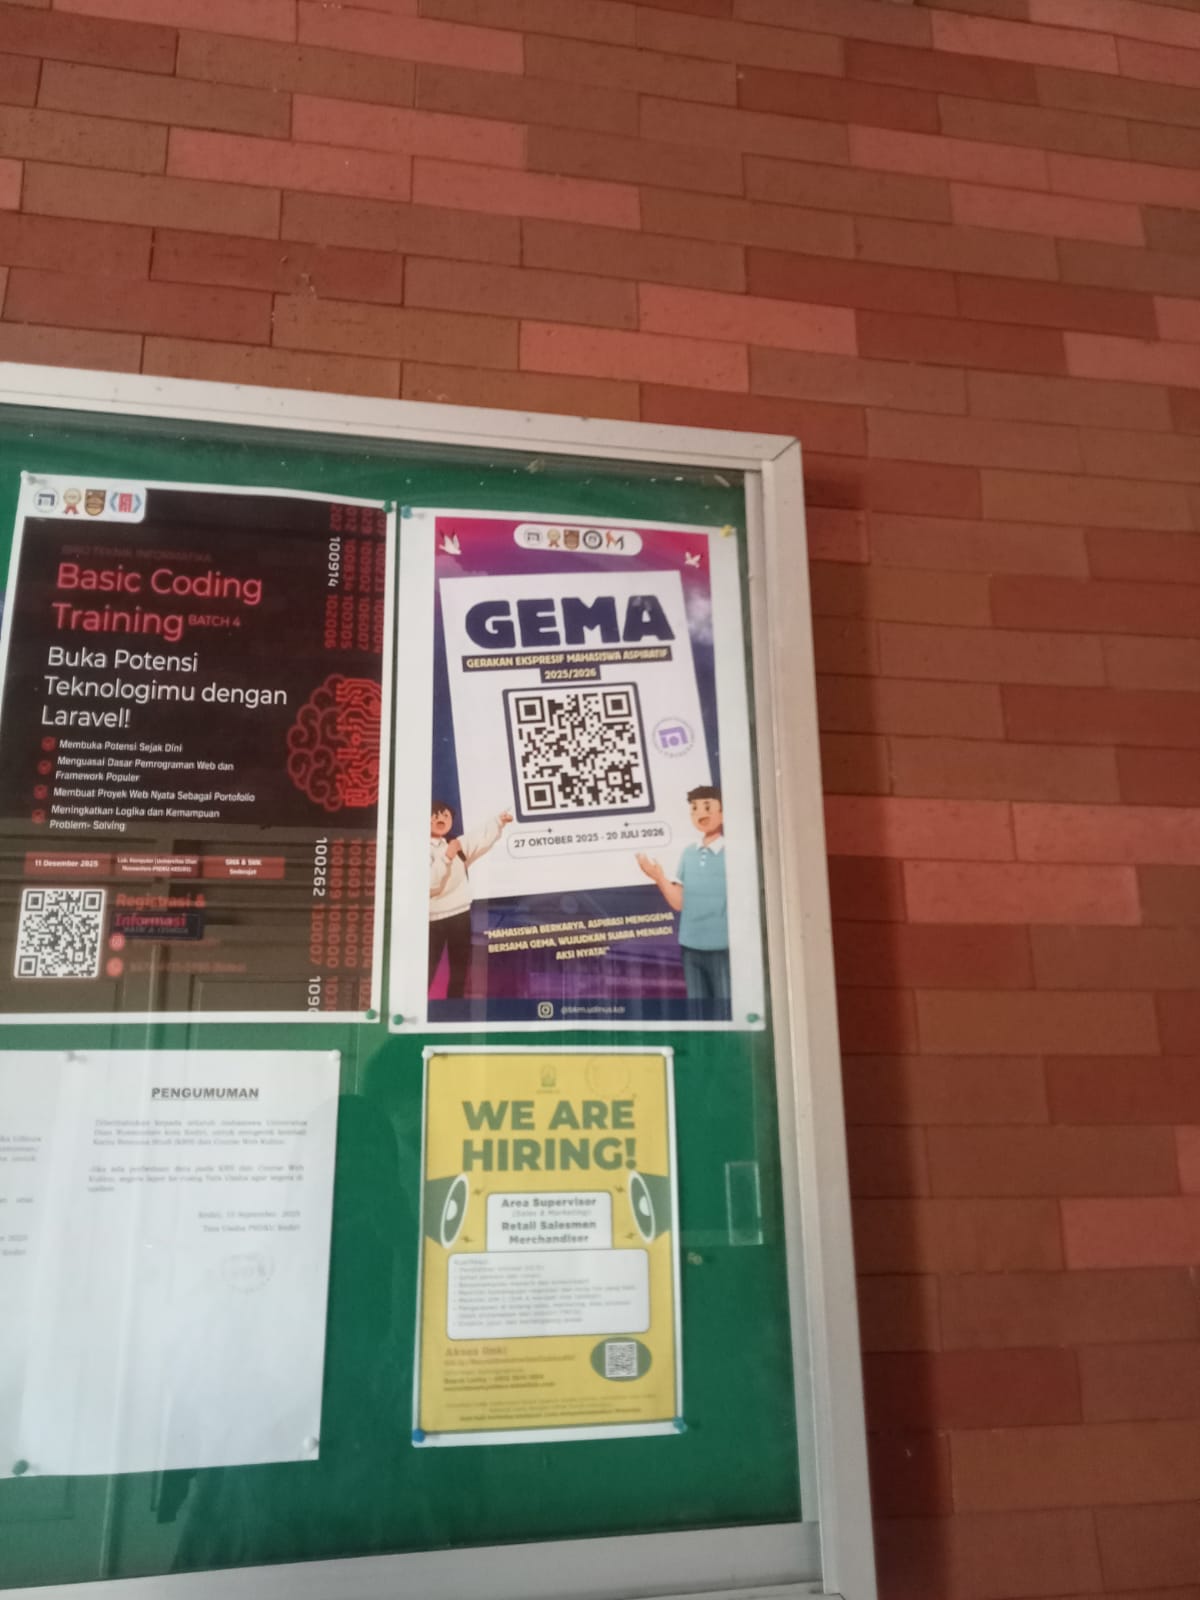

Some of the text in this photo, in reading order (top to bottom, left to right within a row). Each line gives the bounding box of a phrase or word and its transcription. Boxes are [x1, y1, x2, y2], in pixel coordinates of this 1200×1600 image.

[328, 536, 341, 587] 100914
[56, 562, 263, 605] Basic Coding
[51, 602, 241, 642] Training BATCH 4
[464, 594, 676, 650] GEMA
[47, 646, 198, 673] Buka Potensi
[466, 648, 669, 668] GERAKAN EKSPRESIF MAHASISWA ASPIRATIF
[544, 668, 597, 680] 2025/2026
[44, 675, 288, 708] Teknologimu dengan
[41, 705, 131, 728] Laravel!
[59, 739, 182, 753] Membuka Potensi Sejak Dini
[57, 756, 234, 771] Menguasai Dasar Pemrograman Web dan
[55, 770, 140, 783] Framework Populer
[53, 787, 255, 802] Membuat Proyek Web Nyata Sebagai Portofolio
[51, 804, 220, 819] Meningkatkan Logika dan Kemampuan
[49, 820, 126, 832] Problem- Solving
[514, 839, 525, 848] 27
[528, 835, 573, 847] OKTOBER
[576, 833, 599, 842] 2025
[606, 831, 618, 840] 20
[620, 829, 639, 839] JULI
[641, 828, 664, 837] 2026
[34, 859, 42, 867] 11
[43, 859, 79, 868] Desember
[313, 837, 328, 896] 100262
[115, 893, 206, 910] Registrasi &
[114, 912, 187, 928] Informasi
[487, 941, 530, 953] BERSAMA
[558, 932, 606, 945] WUJUDKAN
[607, 929, 636, 940] SUARA
[555, 950, 575, 960] AKSI
[151, 1087, 259, 1100] PENGUMUMAN
[461, 1099, 636, 1131] WE ARE
[461, 1137, 637, 1171] HIRING!
[501, 1197, 597, 1208] Area Supervisor
[501, 1220, 597, 1231] Retail Salesmen
[508, 1234, 590, 1245] Merchandiser
